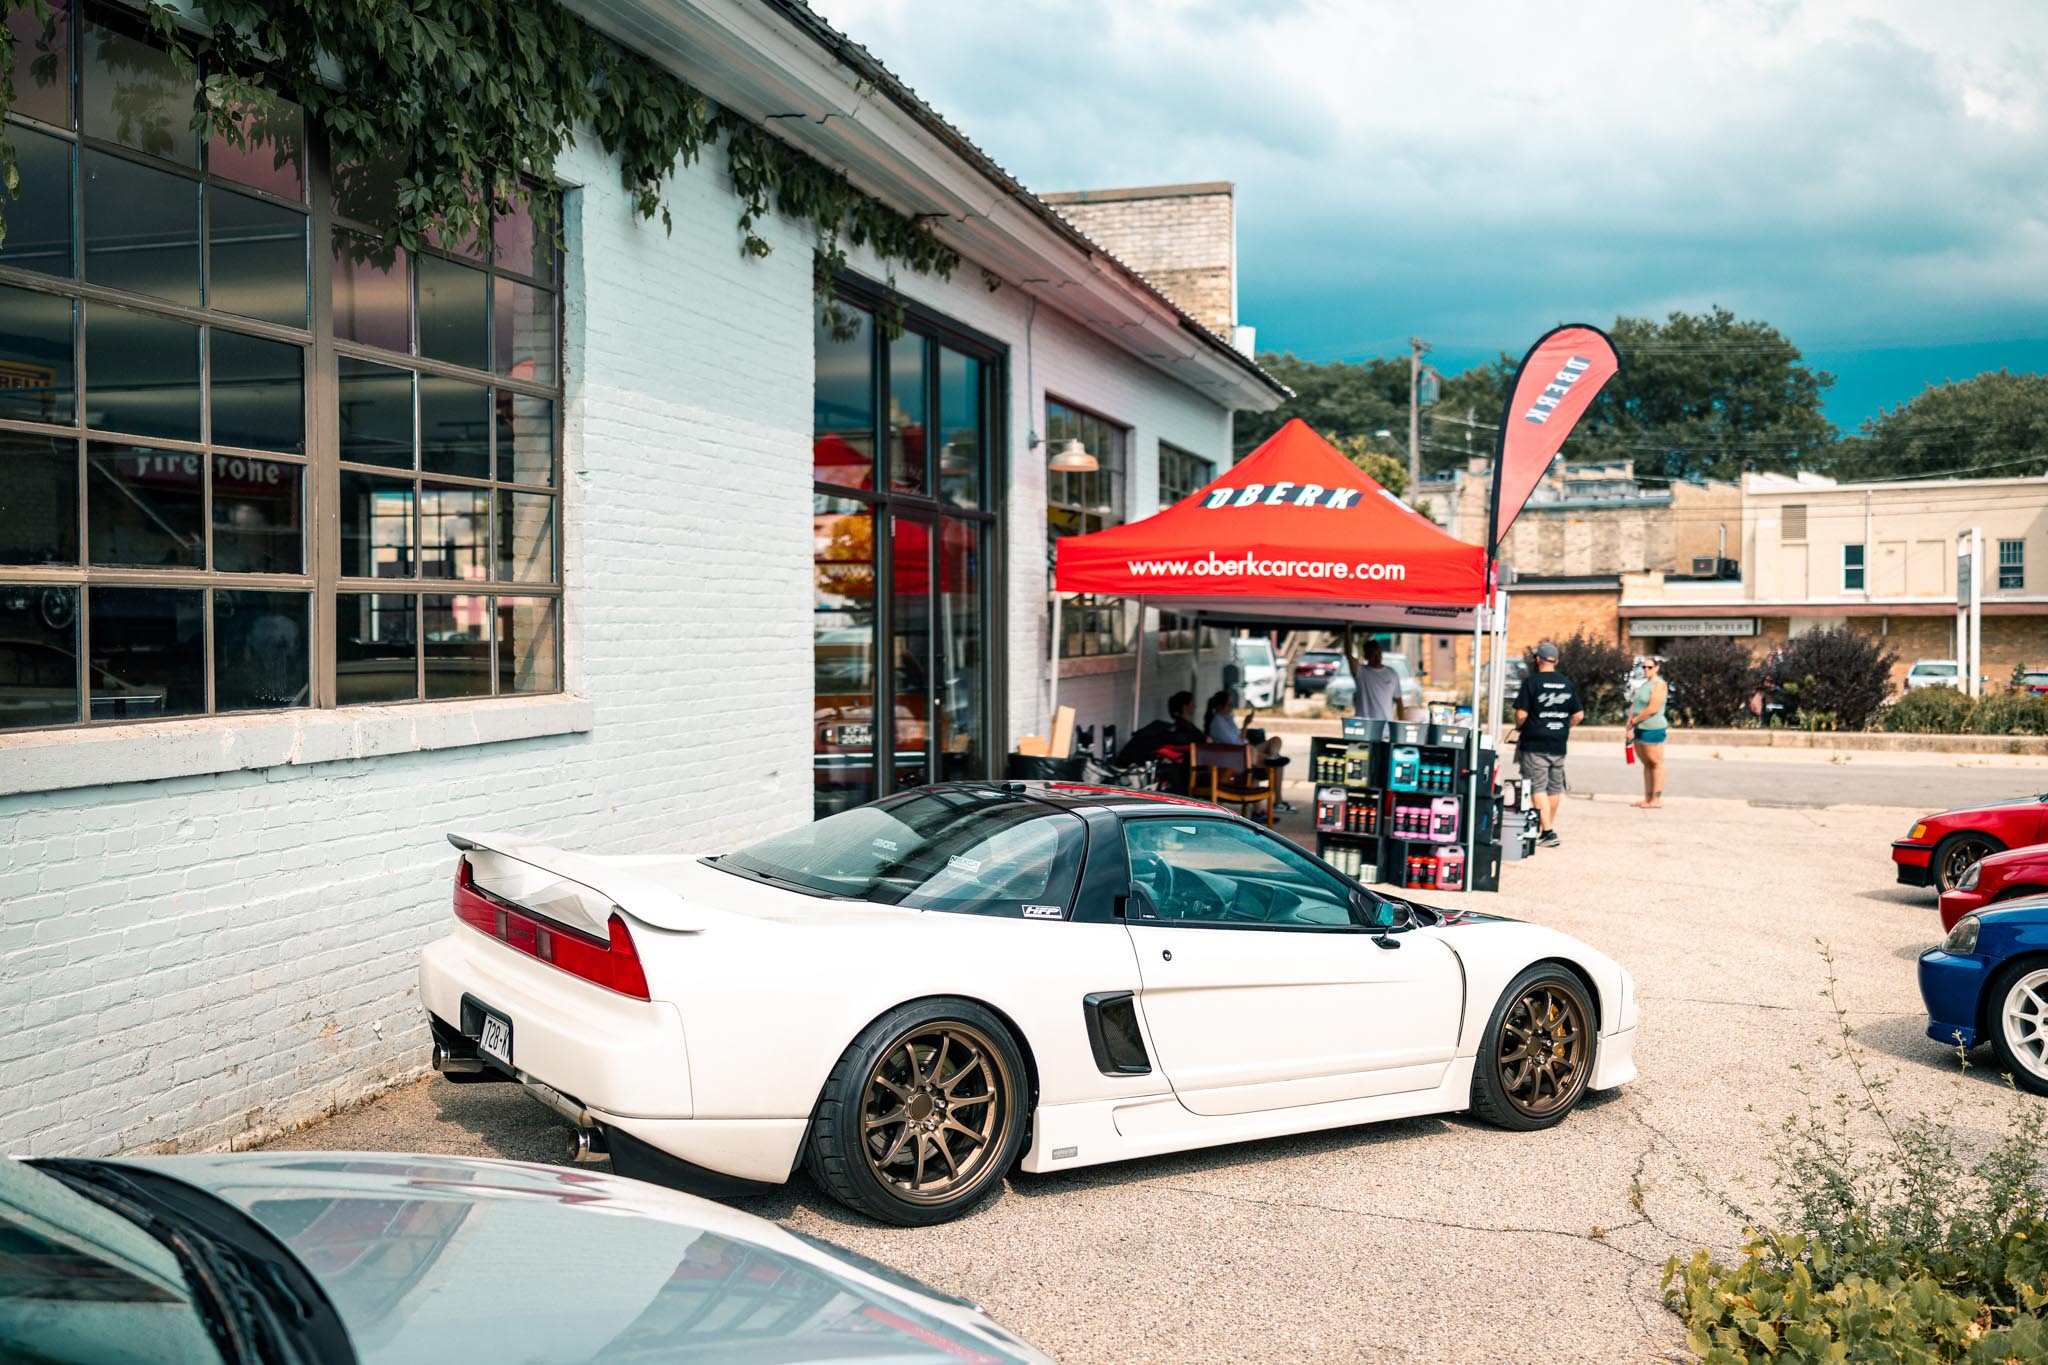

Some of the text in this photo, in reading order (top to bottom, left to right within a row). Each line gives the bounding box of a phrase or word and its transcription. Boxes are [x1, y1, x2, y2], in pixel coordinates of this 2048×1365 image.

[1525, 357, 1590, 422] OBERK
[131, 448, 280, 485] Firetone
[1206, 482, 1359, 510] OBERK
[1127, 551, 1406, 581] www.oberkcarcare.com
[1025, 906, 1060, 915] HFP
